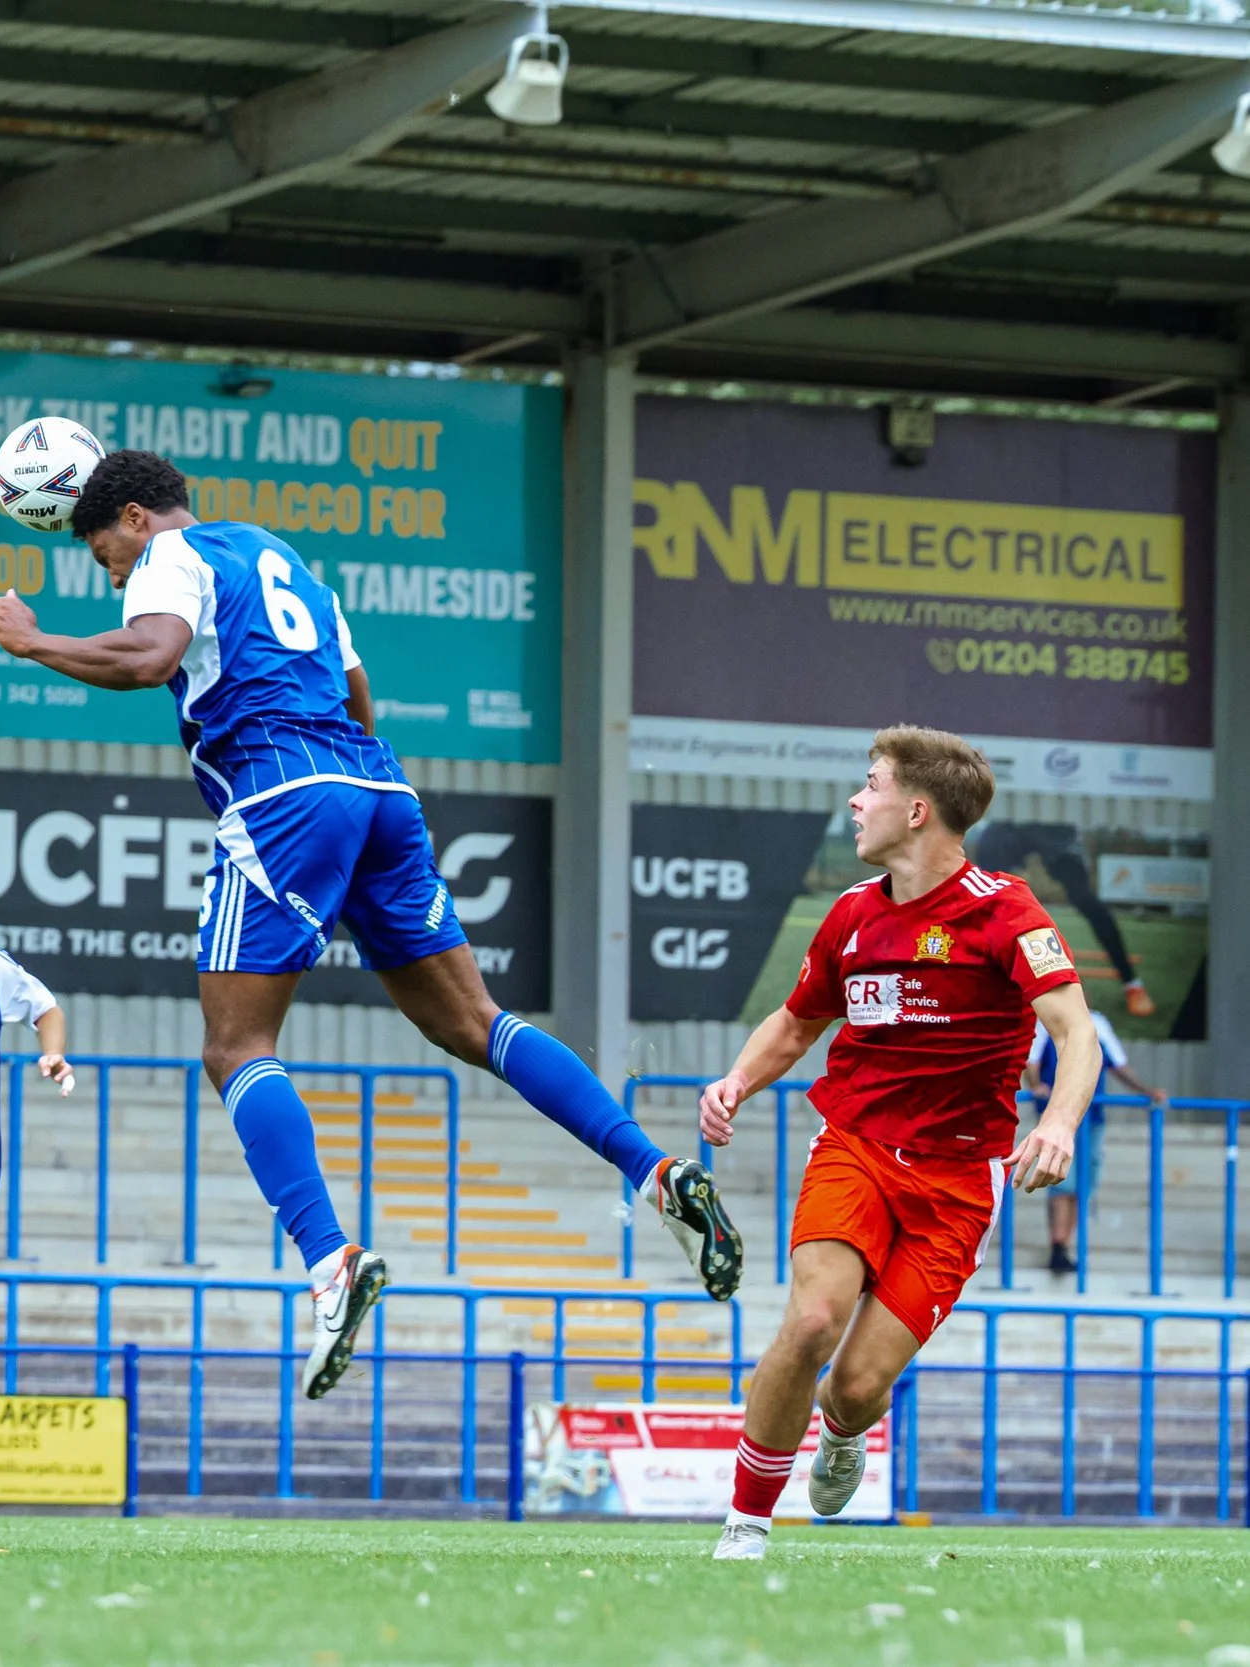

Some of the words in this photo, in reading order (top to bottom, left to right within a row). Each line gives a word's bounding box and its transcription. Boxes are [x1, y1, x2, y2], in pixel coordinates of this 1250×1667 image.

[125, 404, 248, 461] HABIT
[256, 411, 342, 466] AND
[350, 417, 443, 478] QUIT
[369, 486, 446, 539] FOR
[633, 477, 823, 589] RNM
[843, 520, 1167, 583] ELECTRICAL
[257, 548, 318, 653] 6
[338, 561, 536, 622] TAMESIDE
[956, 638, 1057, 676] 01204
[1064, 644, 1190, 685] 388745
[632, 856, 749, 901] UCFB
[67, 928, 127, 957] THE
[651, 926, 730, 971] GIS
[1020, 929, 1062, 961] bd
[847, 979, 882, 1005] CR
[895, 977, 922, 991] Safe
[896, 995, 939, 1008] Service
[894, 1012, 951, 1024] Solutions
